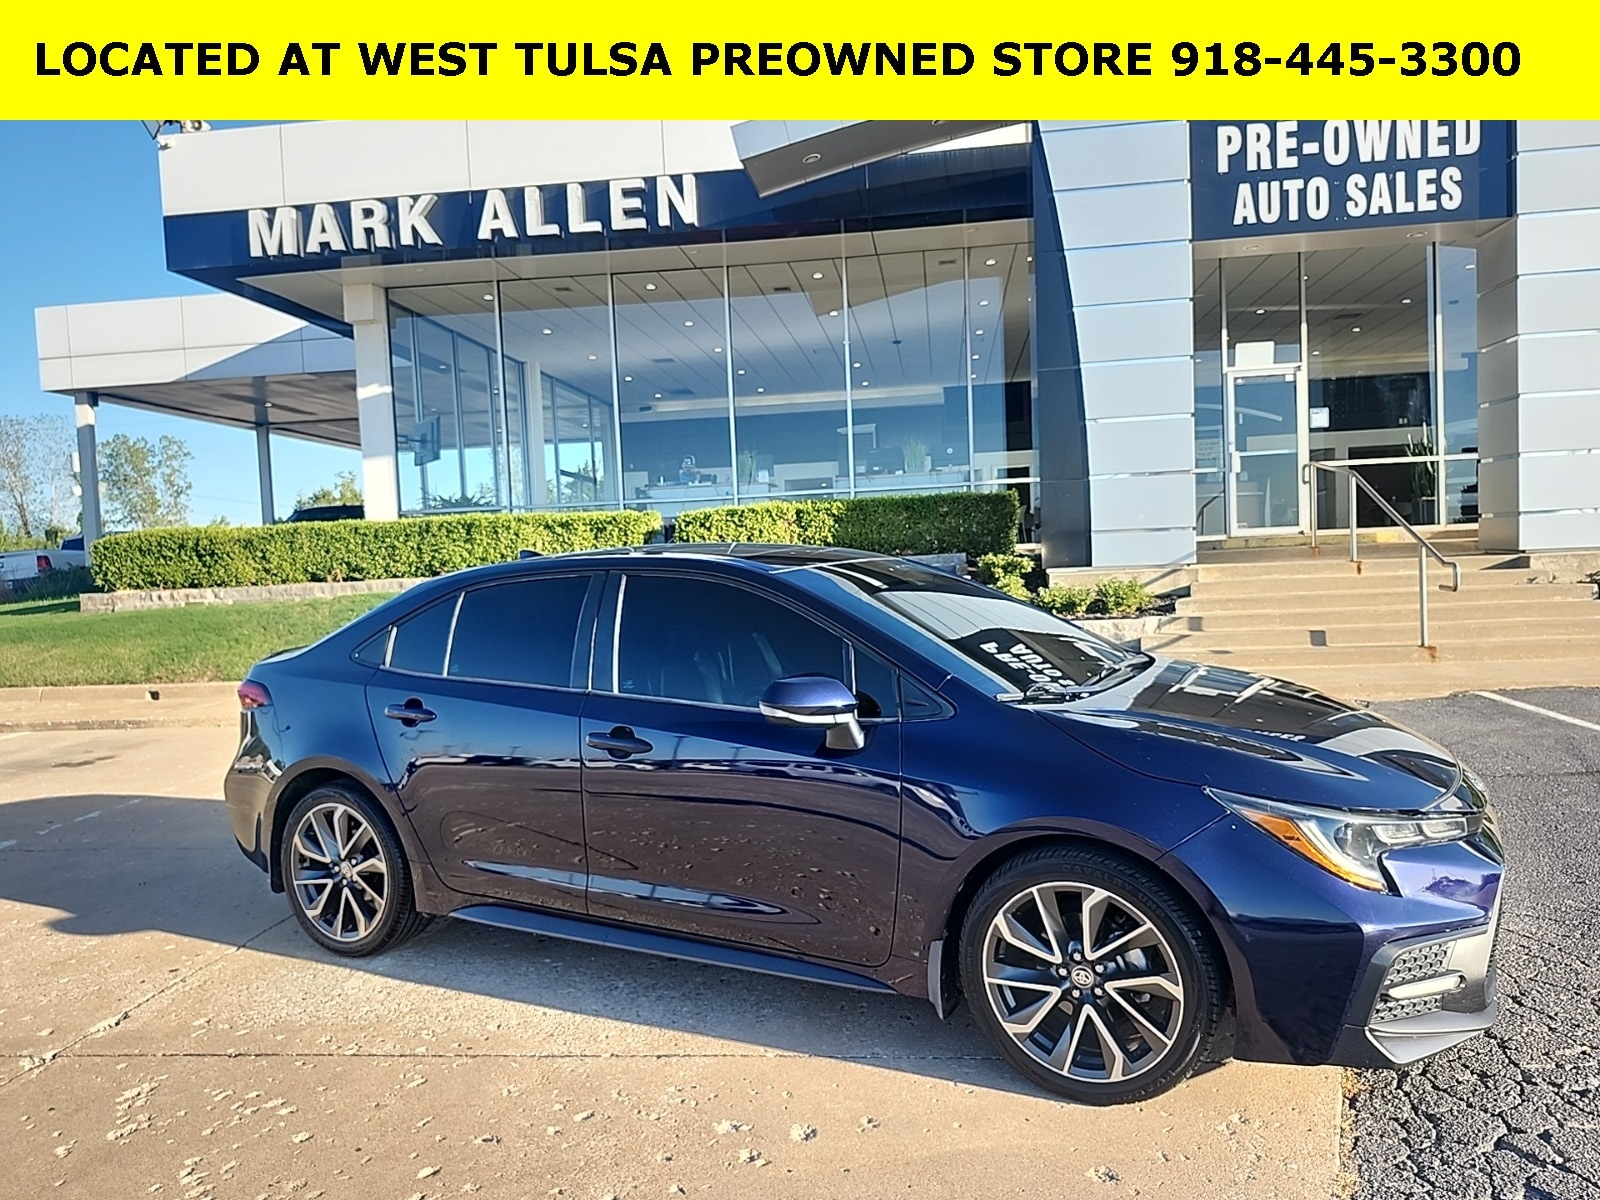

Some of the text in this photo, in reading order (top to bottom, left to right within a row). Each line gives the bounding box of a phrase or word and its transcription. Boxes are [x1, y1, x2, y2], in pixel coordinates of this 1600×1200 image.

[1216, 120, 1482, 174] PRE-OWNED
[247, 173, 699, 258] MARK ALLEN
[1233, 165, 1463, 226] AUTO SALES
